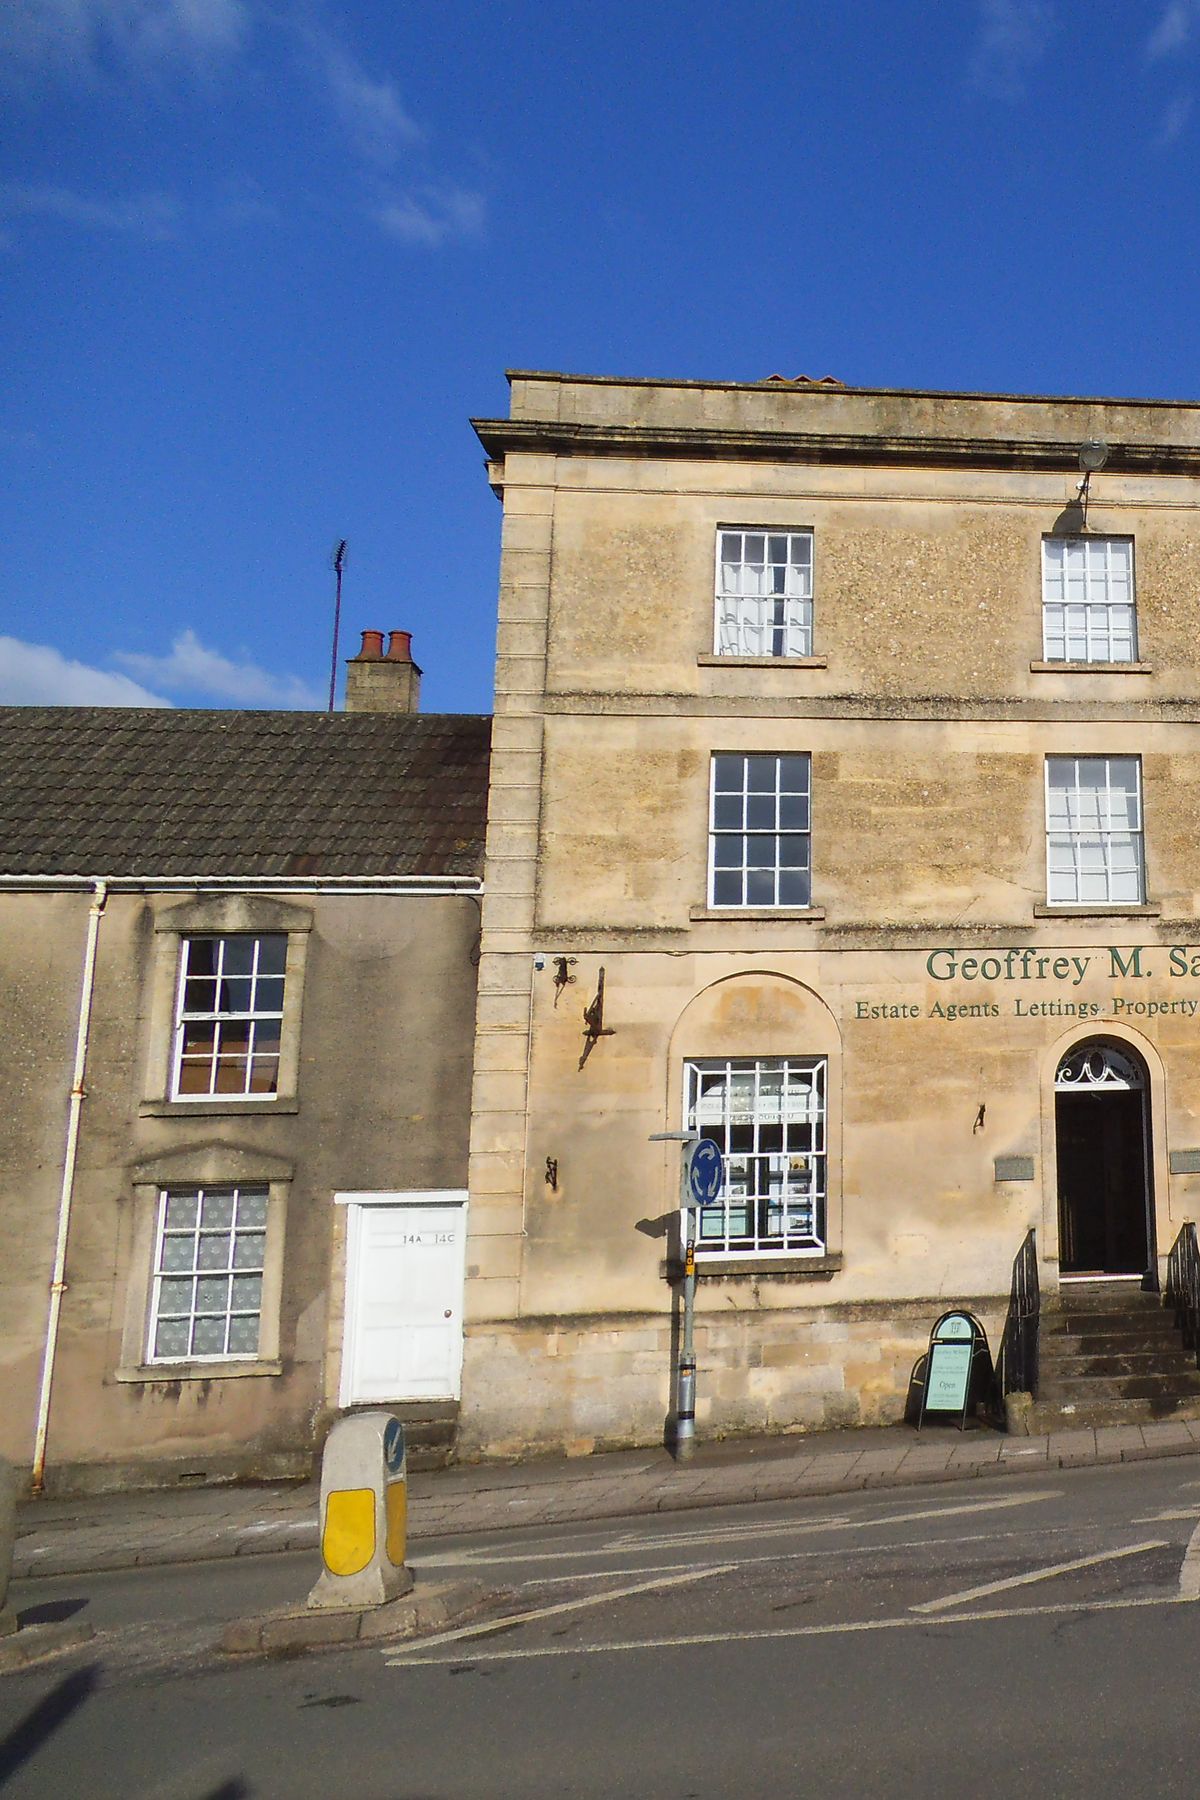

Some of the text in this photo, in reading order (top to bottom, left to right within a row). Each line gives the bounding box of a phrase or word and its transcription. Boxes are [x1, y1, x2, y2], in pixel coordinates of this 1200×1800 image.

[926, 947, 1090, 985] Geoffrey
[1108, 946, 1152, 978] M.
[855, 1001, 920, 1019] Estate
[928, 1000, 1000, 1021] Agents
[1014, 998, 1099, 1019] Lettings
[1112, 997, 1198, 1017] Property
[403, 1233, 456, 1244] 14A 14C
